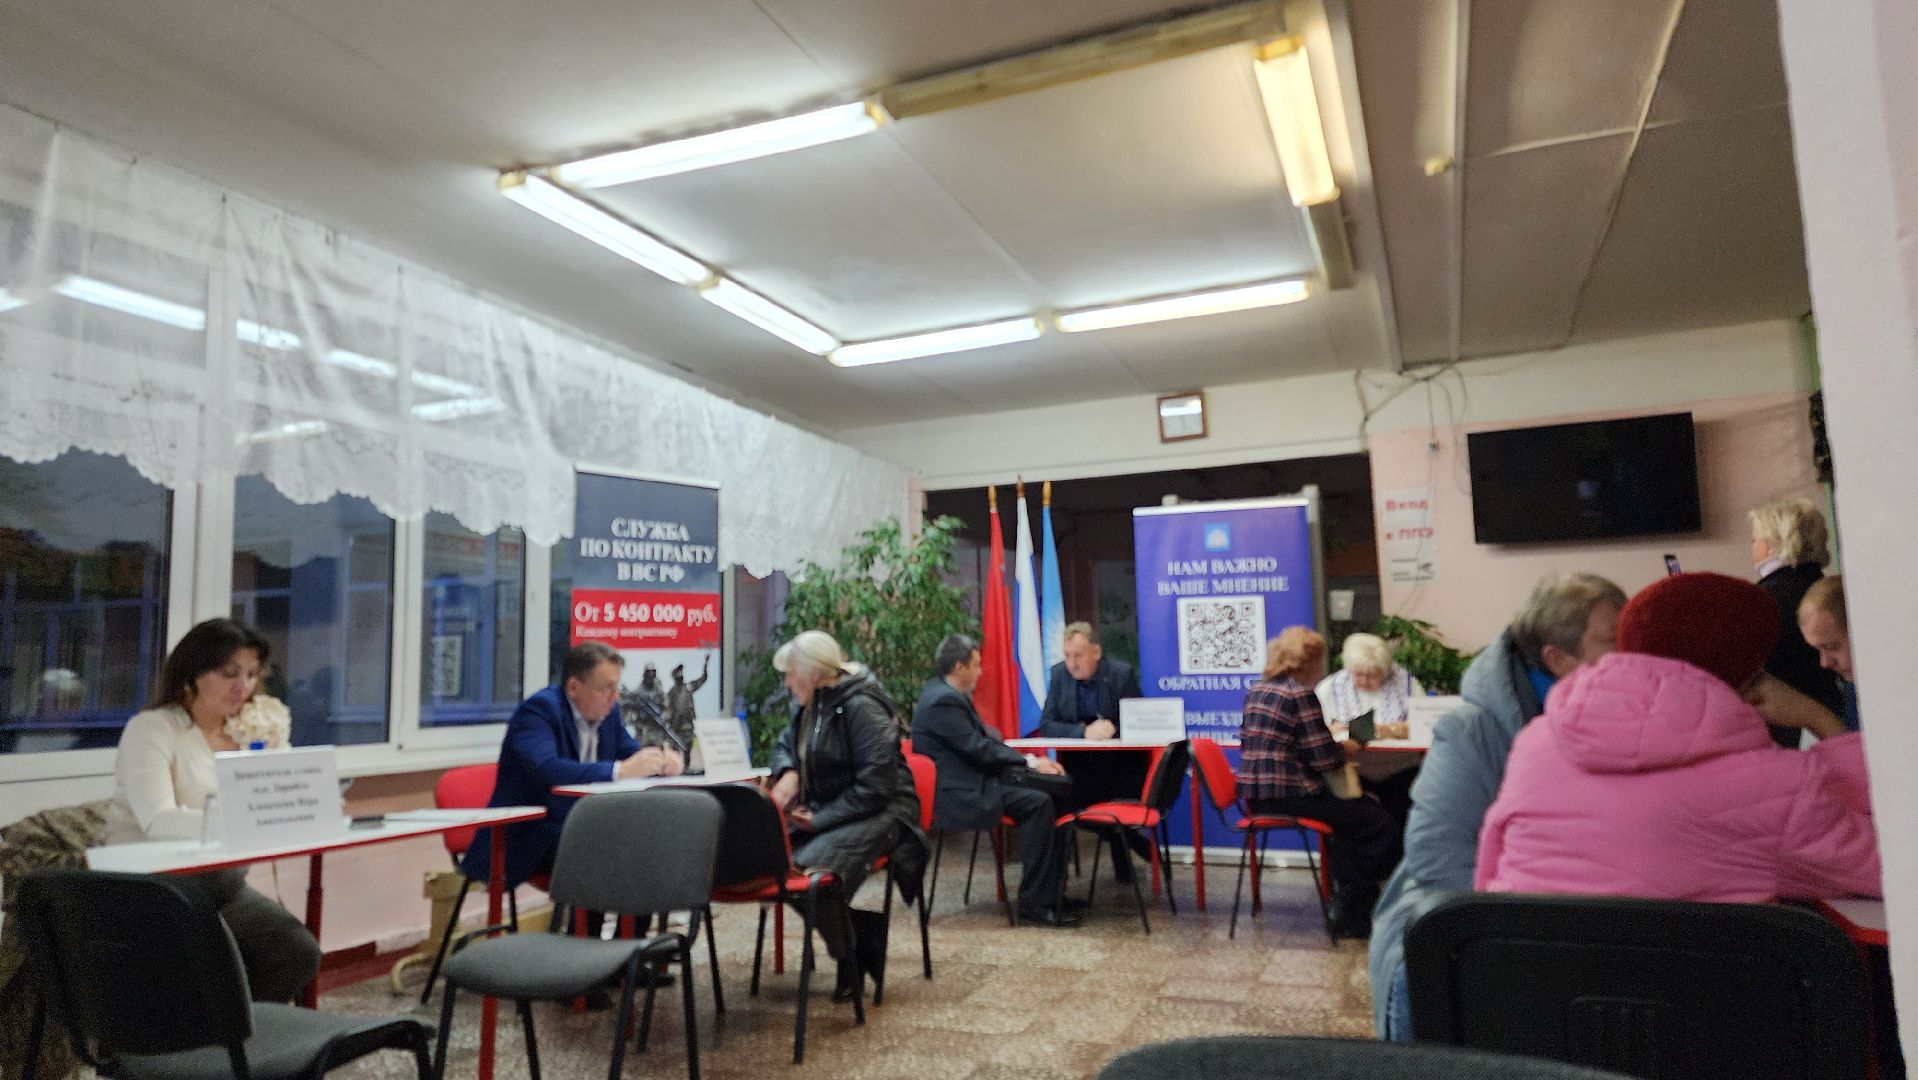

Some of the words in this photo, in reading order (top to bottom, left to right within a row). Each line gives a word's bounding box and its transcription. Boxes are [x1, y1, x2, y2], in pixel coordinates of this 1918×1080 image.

[1386, 500, 1428, 511] Вход
[611, 517, 690, 541] СЛУЖБА
[581, 538, 610, 558] ПО
[612, 540, 717, 563] КОНТРАКТУ
[617, 562, 631, 581] В
[659, 564, 685, 583] РФ
[1168, 560, 1208, 576] НАМ
[1211, 557, 1277, 575] ВАЖНО
[1158, 579, 1209, 595] ВАШЕ
[1213, 577, 1289, 593] МНЕНИЕ
[574, 602, 599, 622] От
[603, 602, 616, 622] 5
[618, 602, 650, 622] 450
[653, 603, 684, 622] 000
[687, 604, 717, 627] руб.
[1159, 675, 1241, 690] ОБРАТНАЯ
